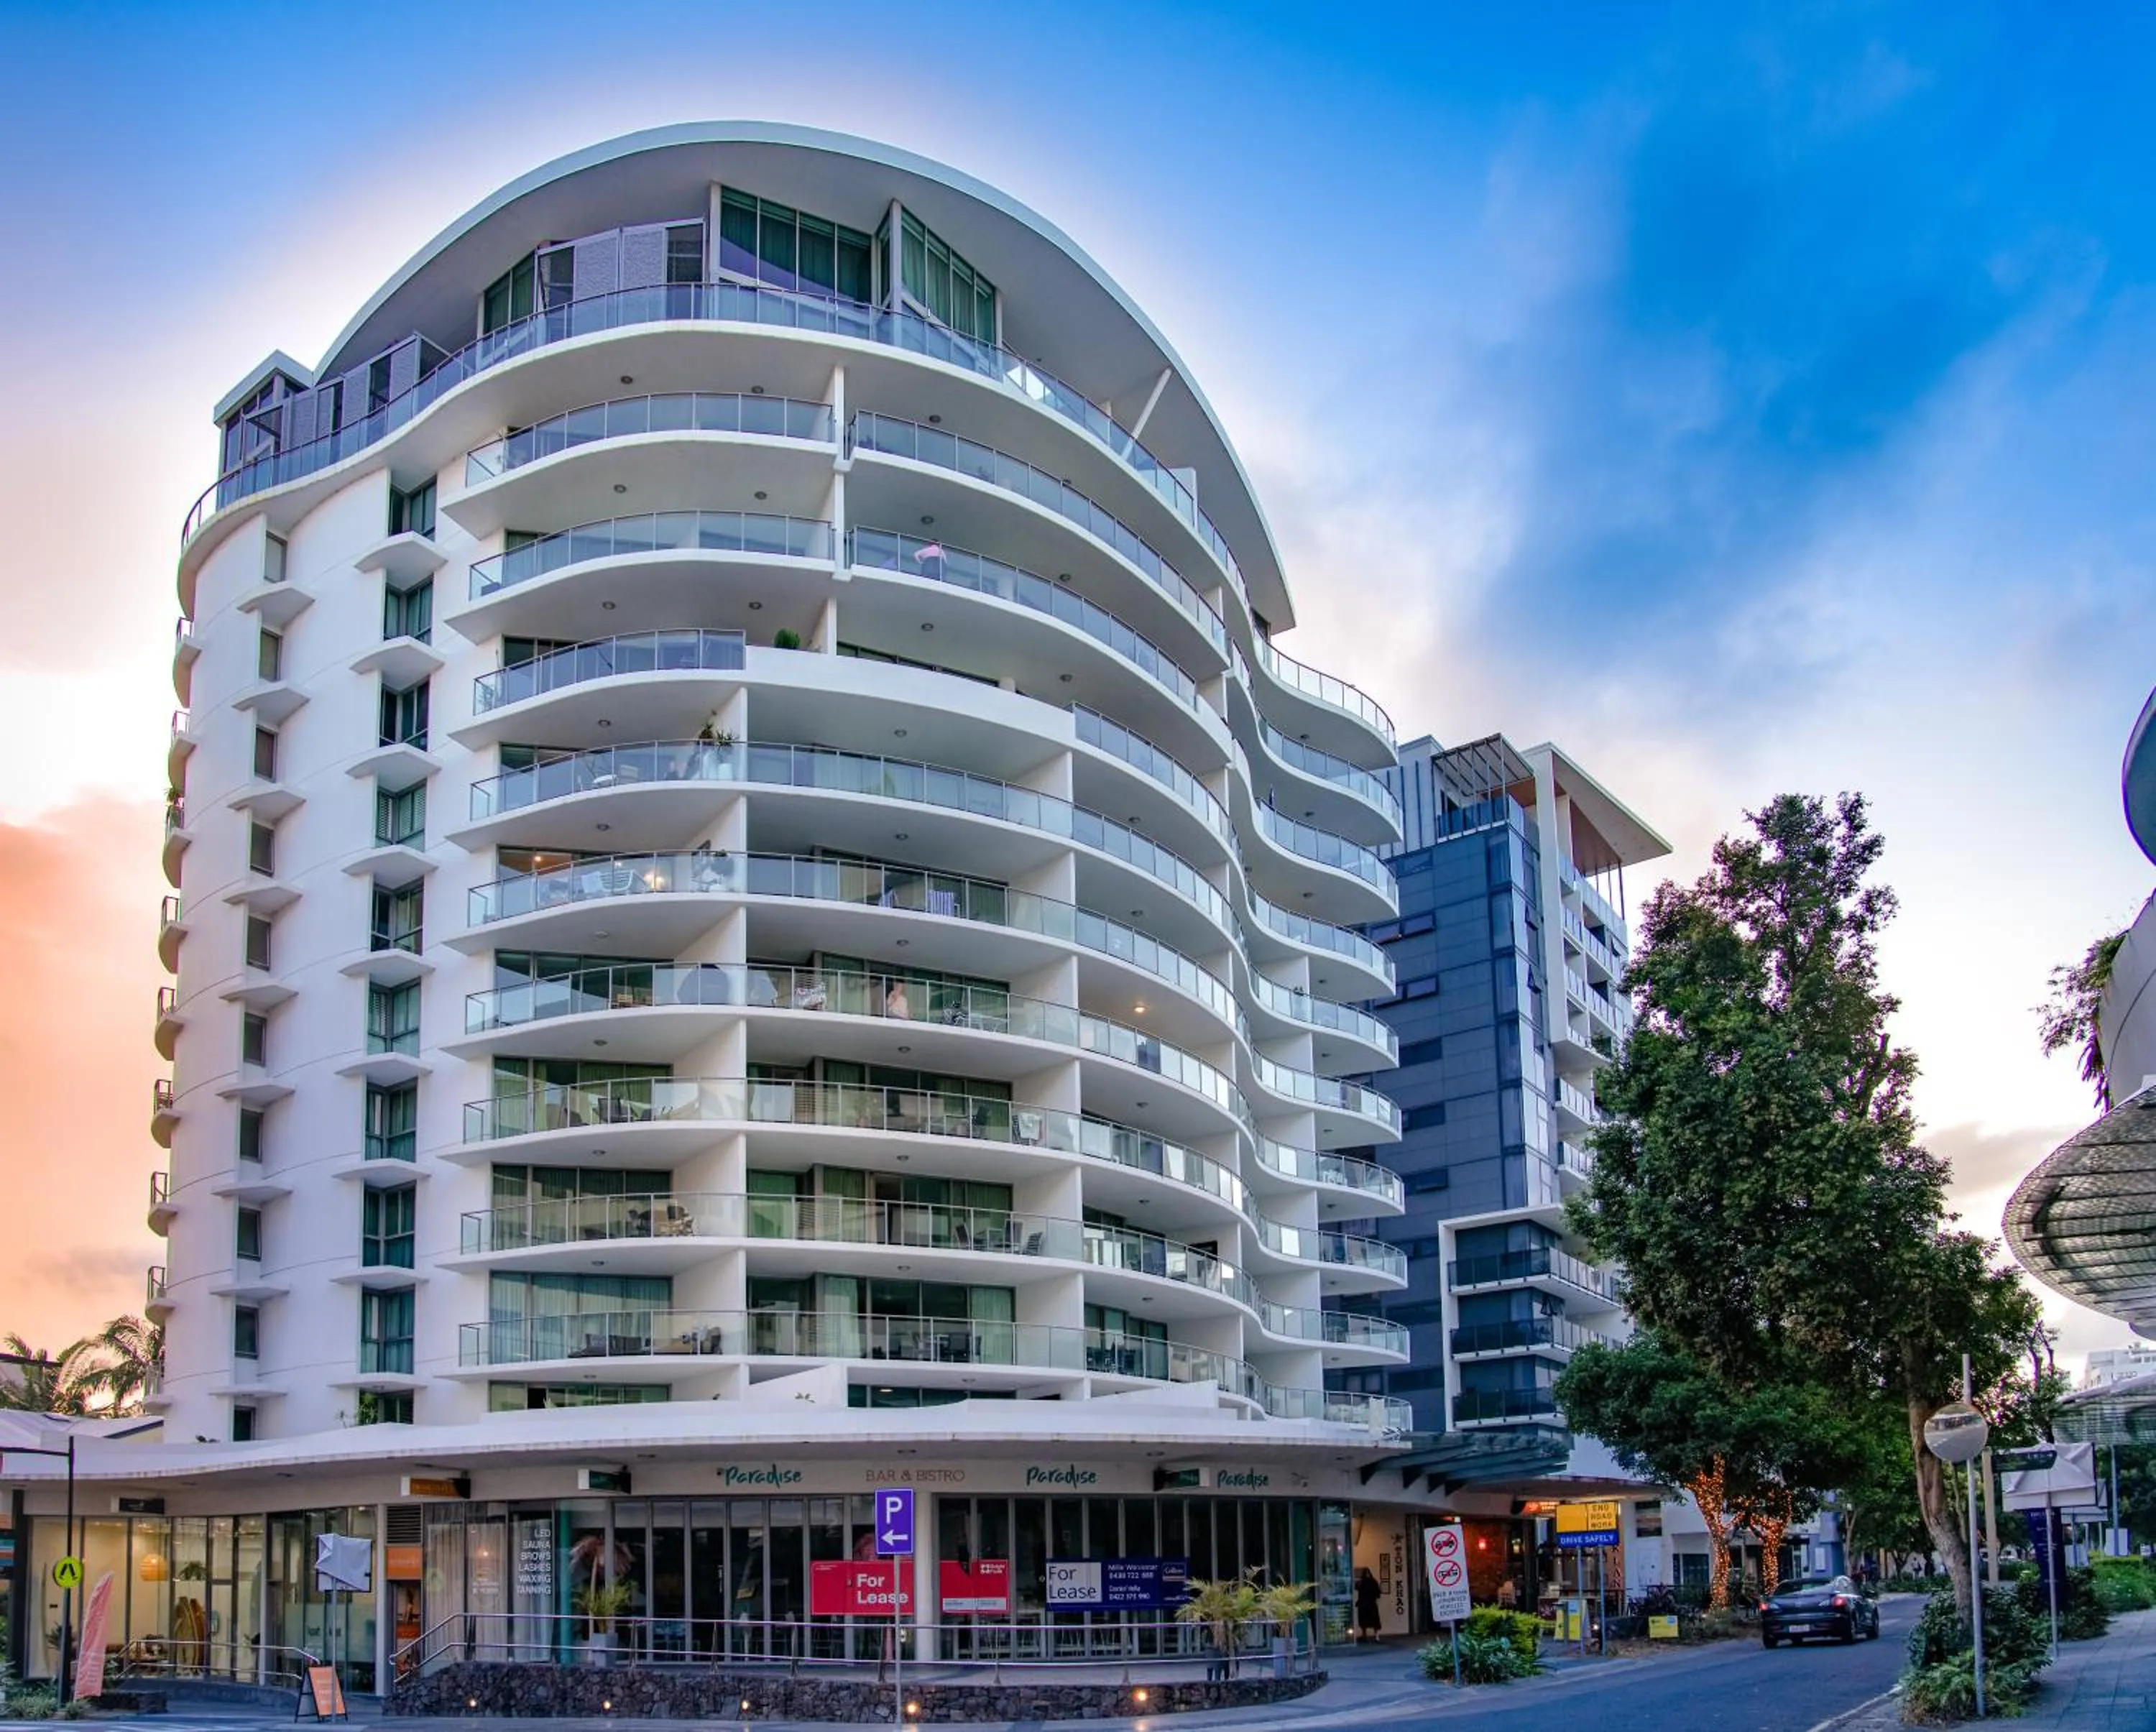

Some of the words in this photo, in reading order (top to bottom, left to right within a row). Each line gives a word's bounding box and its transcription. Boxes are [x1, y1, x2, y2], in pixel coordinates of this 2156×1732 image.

[865, 1470, 895, 1483] BAR
[900, 1470, 912, 1482] &
[916, 1470, 965, 1483] BISTRO
[885, 1496, 903, 1524] P
[534, 1529, 551, 1538] LED
[1585, 1534, 1614, 1543] SAFELY
[520, 1552, 551, 1560] BROWS
[518, 1563, 551, 1572] LASHES
[1048, 1565, 1077, 1580] For
[518, 1574, 551, 1583] WAXING
[857, 1573, 885, 1588] For
[516, 1585, 551, 1595] TANNING
[1049, 1585, 1097, 1600] Lease
[857, 1590, 908, 1604] Lease
